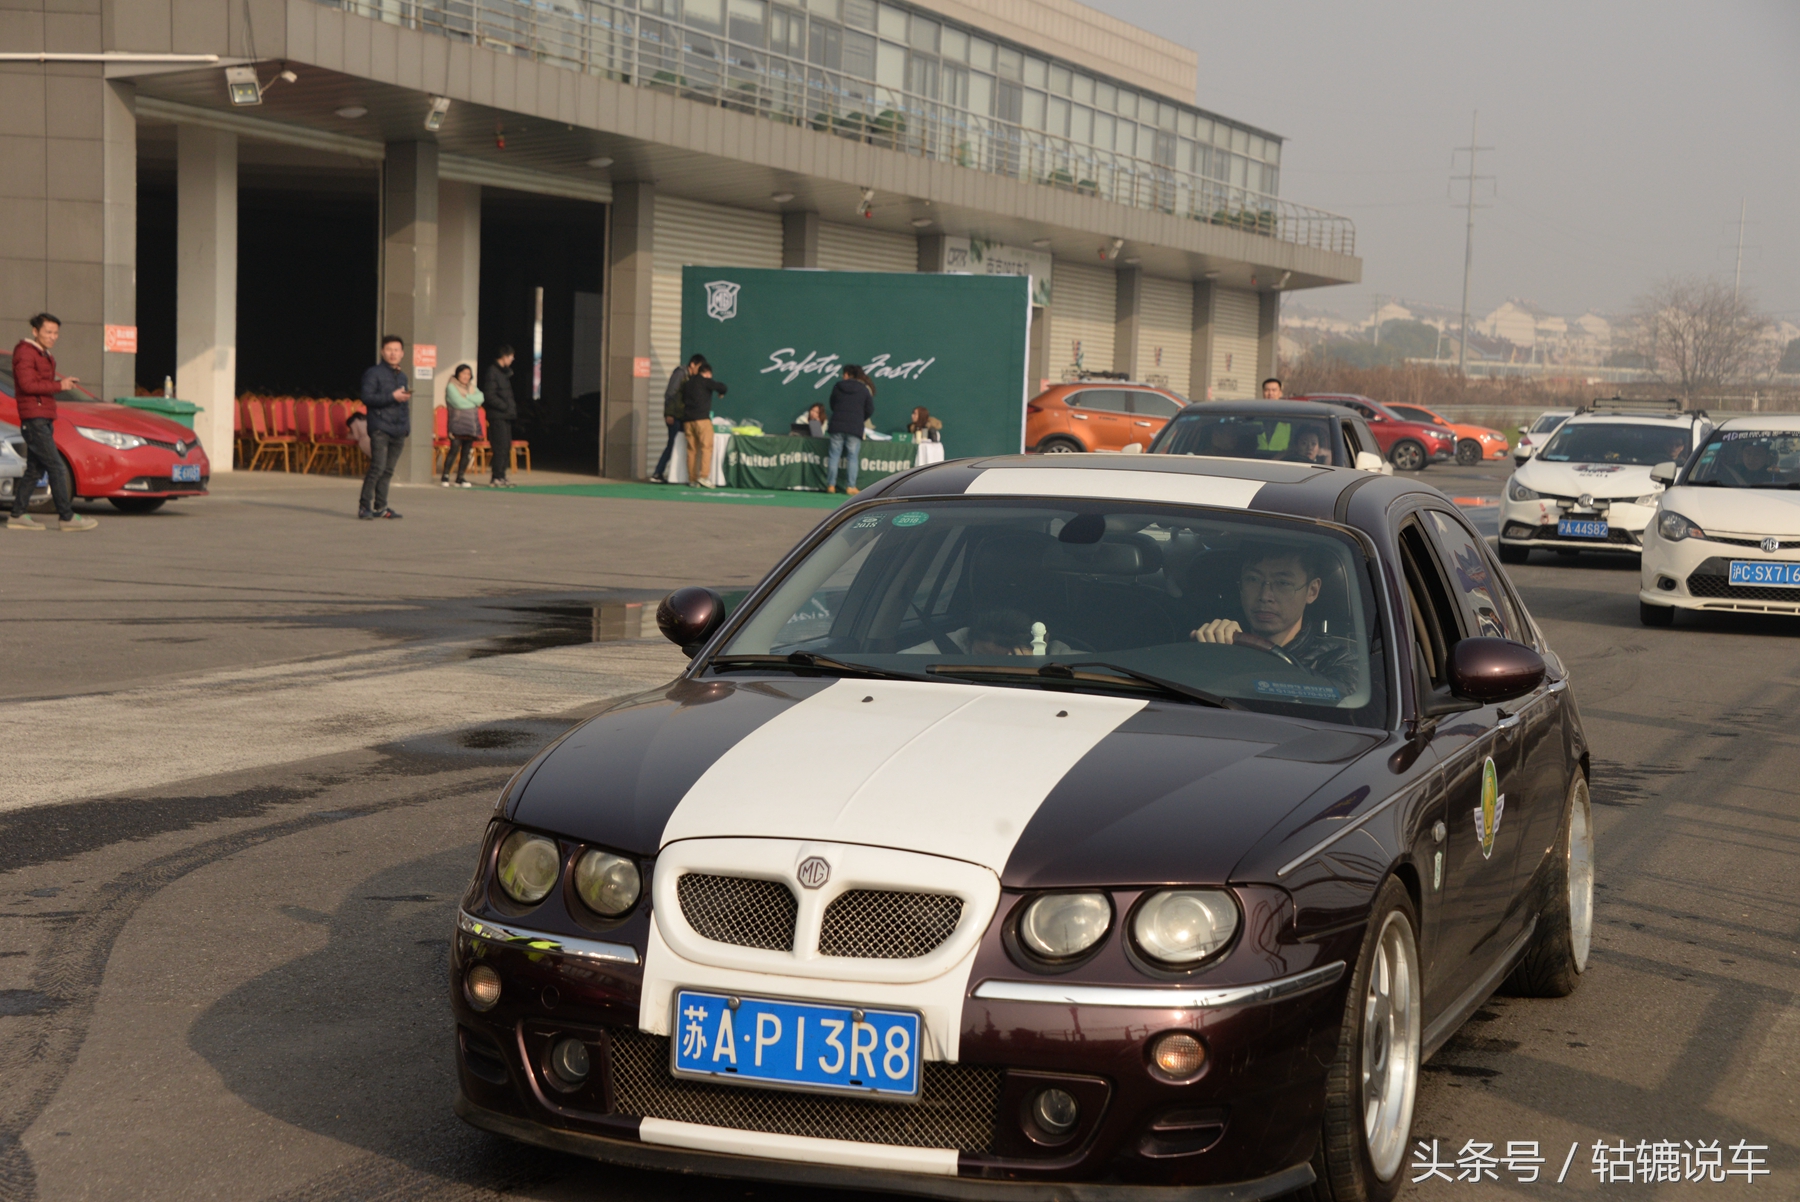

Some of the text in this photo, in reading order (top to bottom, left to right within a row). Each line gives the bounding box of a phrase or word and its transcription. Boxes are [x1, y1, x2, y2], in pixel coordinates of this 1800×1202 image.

[760, 347, 935, 389] Safety Fast!
[739, 452, 777, 468] United
[780, 451, 821, 466] Friends
[1732, 564, 1800, 582] 沪C·SX716
[802, 861, 825, 884] MG
[682, 1005, 911, 1081] 苏A·P13R8
